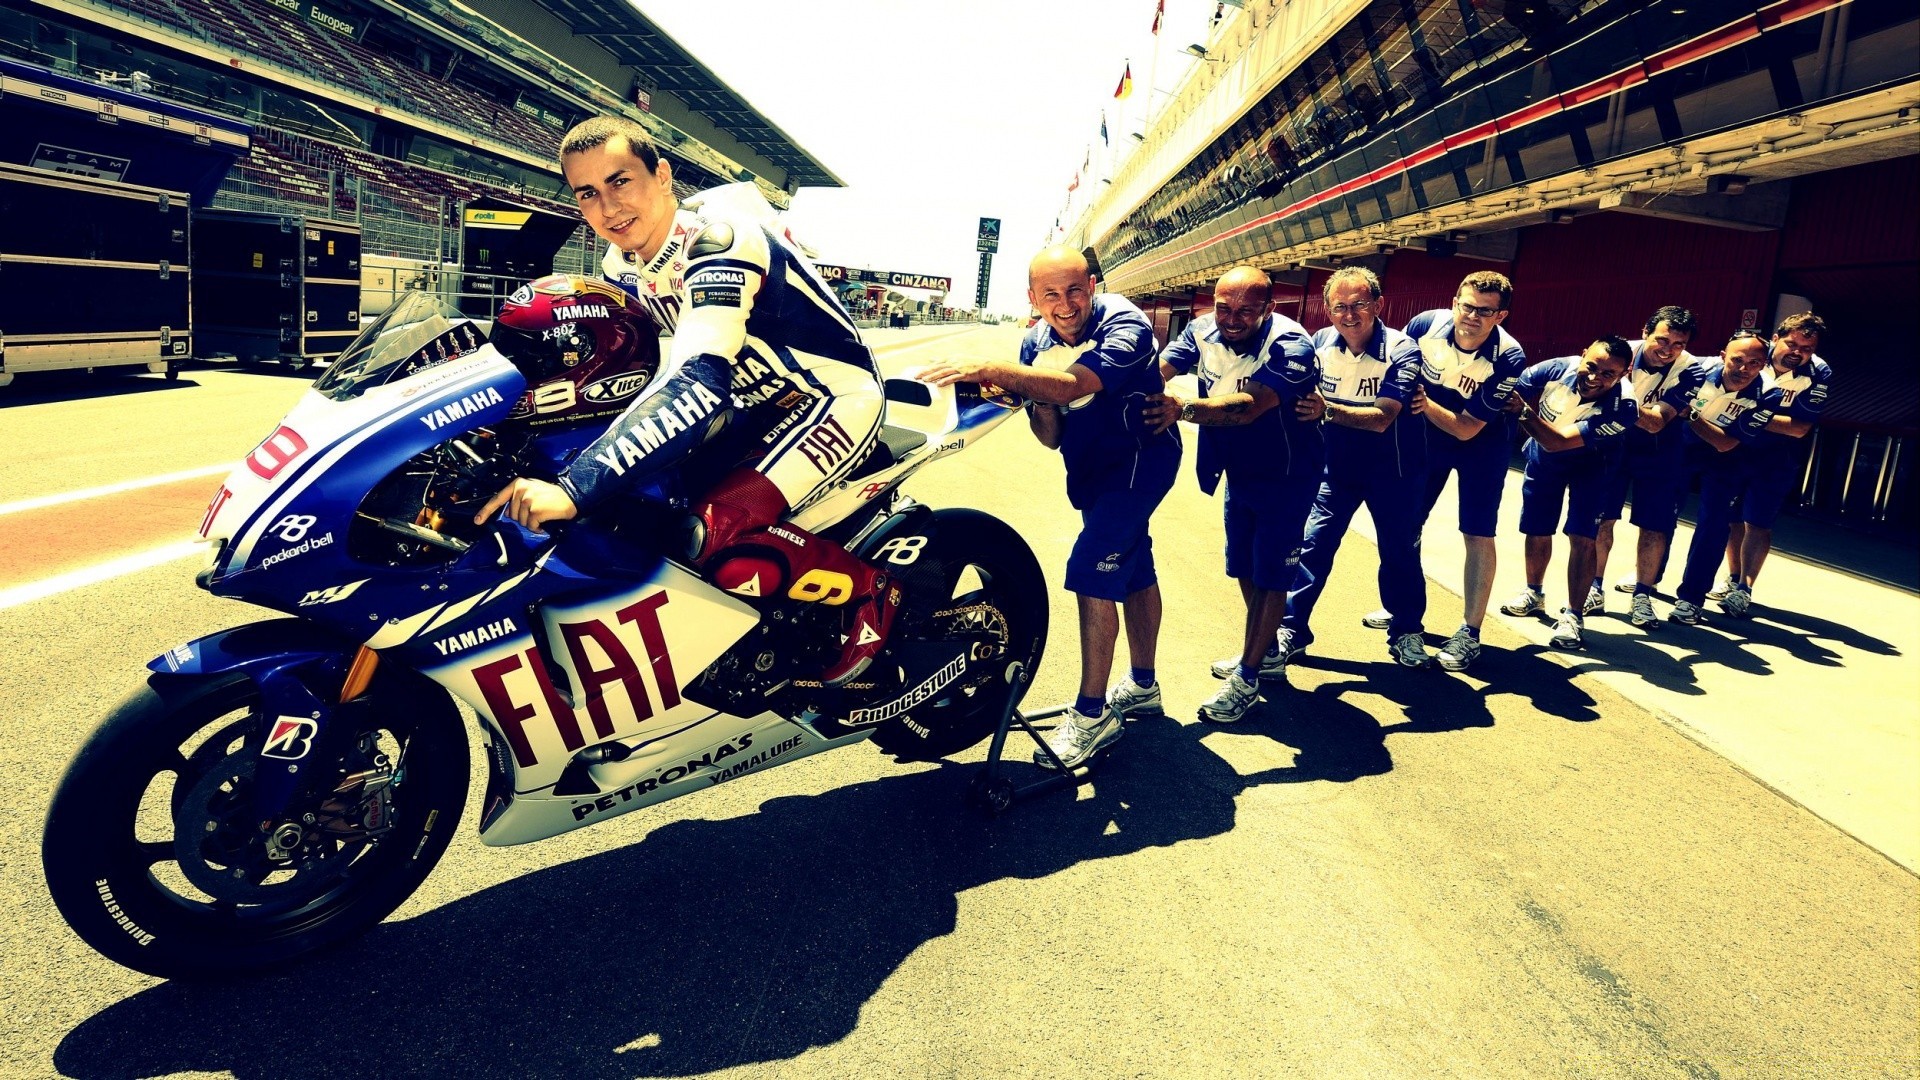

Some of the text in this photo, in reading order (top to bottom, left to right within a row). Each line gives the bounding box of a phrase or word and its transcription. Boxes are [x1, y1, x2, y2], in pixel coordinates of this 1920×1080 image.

[310, 6, 355, 34] Europcar
[516, 98, 539, 115] Europcar
[543, 110, 564, 126] Europcar
[649, 240, 681, 274] YAMAHA
[892, 273, 947, 289] CINZANO
[542, 323, 576, 342] X-802
[553, 305, 609, 321] YAMAHA
[420, 387, 504, 431] YAMAHA
[595, 381, 722, 477] YAMAHA
[796, 413, 855, 477] FIAT
[941, 439, 965, 452] bell
[262, 532, 333, 570] packard bell
[433, 617, 517, 657] YAMAHA
[471, 590, 681, 768] FIAT
[850, 652, 966, 725] BRIDGESTONE
[571, 732, 754, 822] PETRONAS
[709, 733, 804, 785] YAMALUBE
[95, 878, 156, 946] BRIDGESTONE
